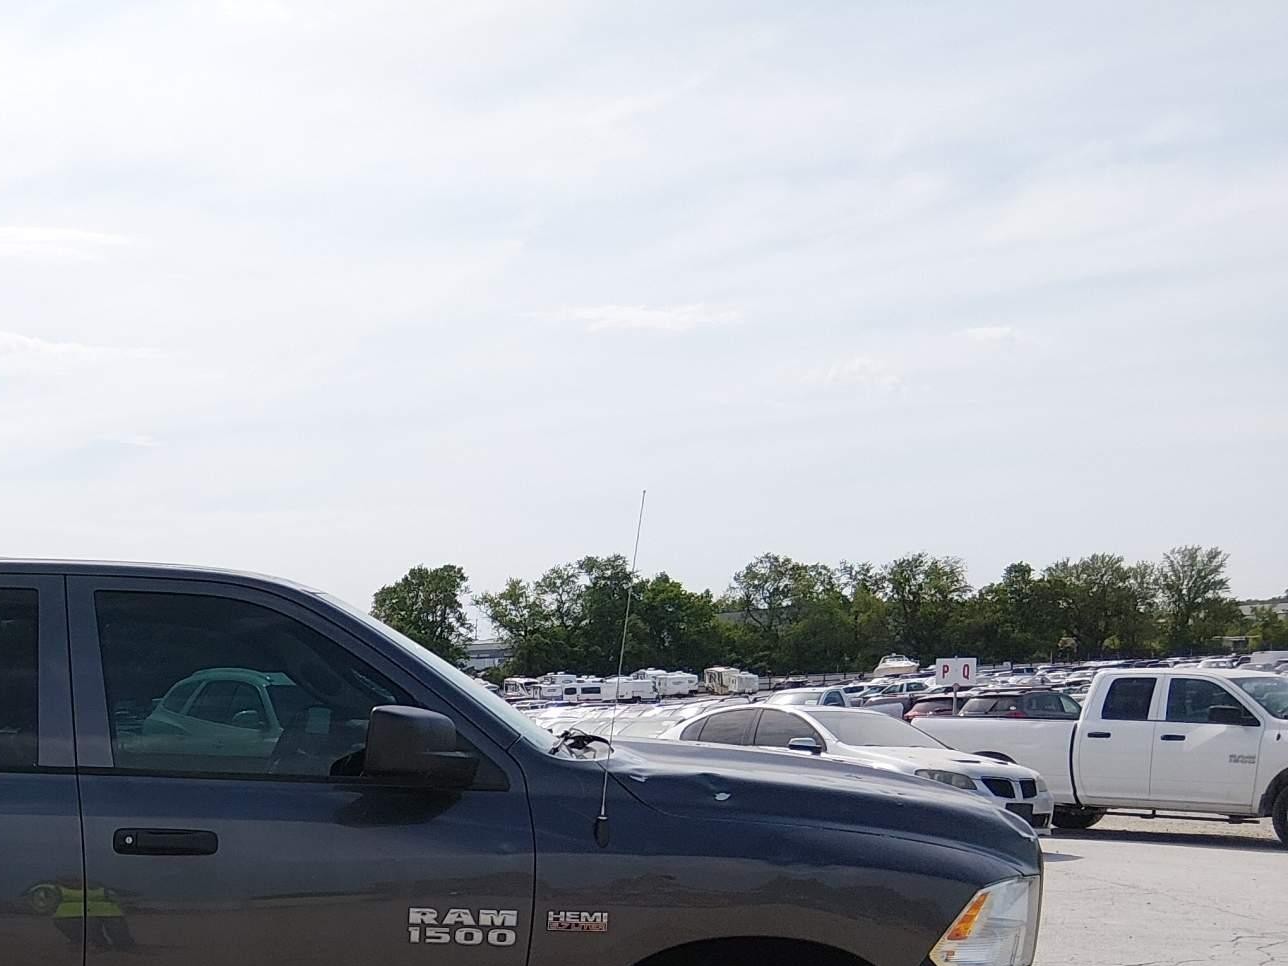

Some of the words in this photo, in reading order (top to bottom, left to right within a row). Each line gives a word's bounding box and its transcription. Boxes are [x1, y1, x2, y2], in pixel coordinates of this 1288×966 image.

[942, 664, 950, 680] P
[962, 663, 970, 681] Q
[408, 907, 518, 927] RAM
[547, 911, 608, 922] HEMI
[408, 926, 516, 946] 1500
